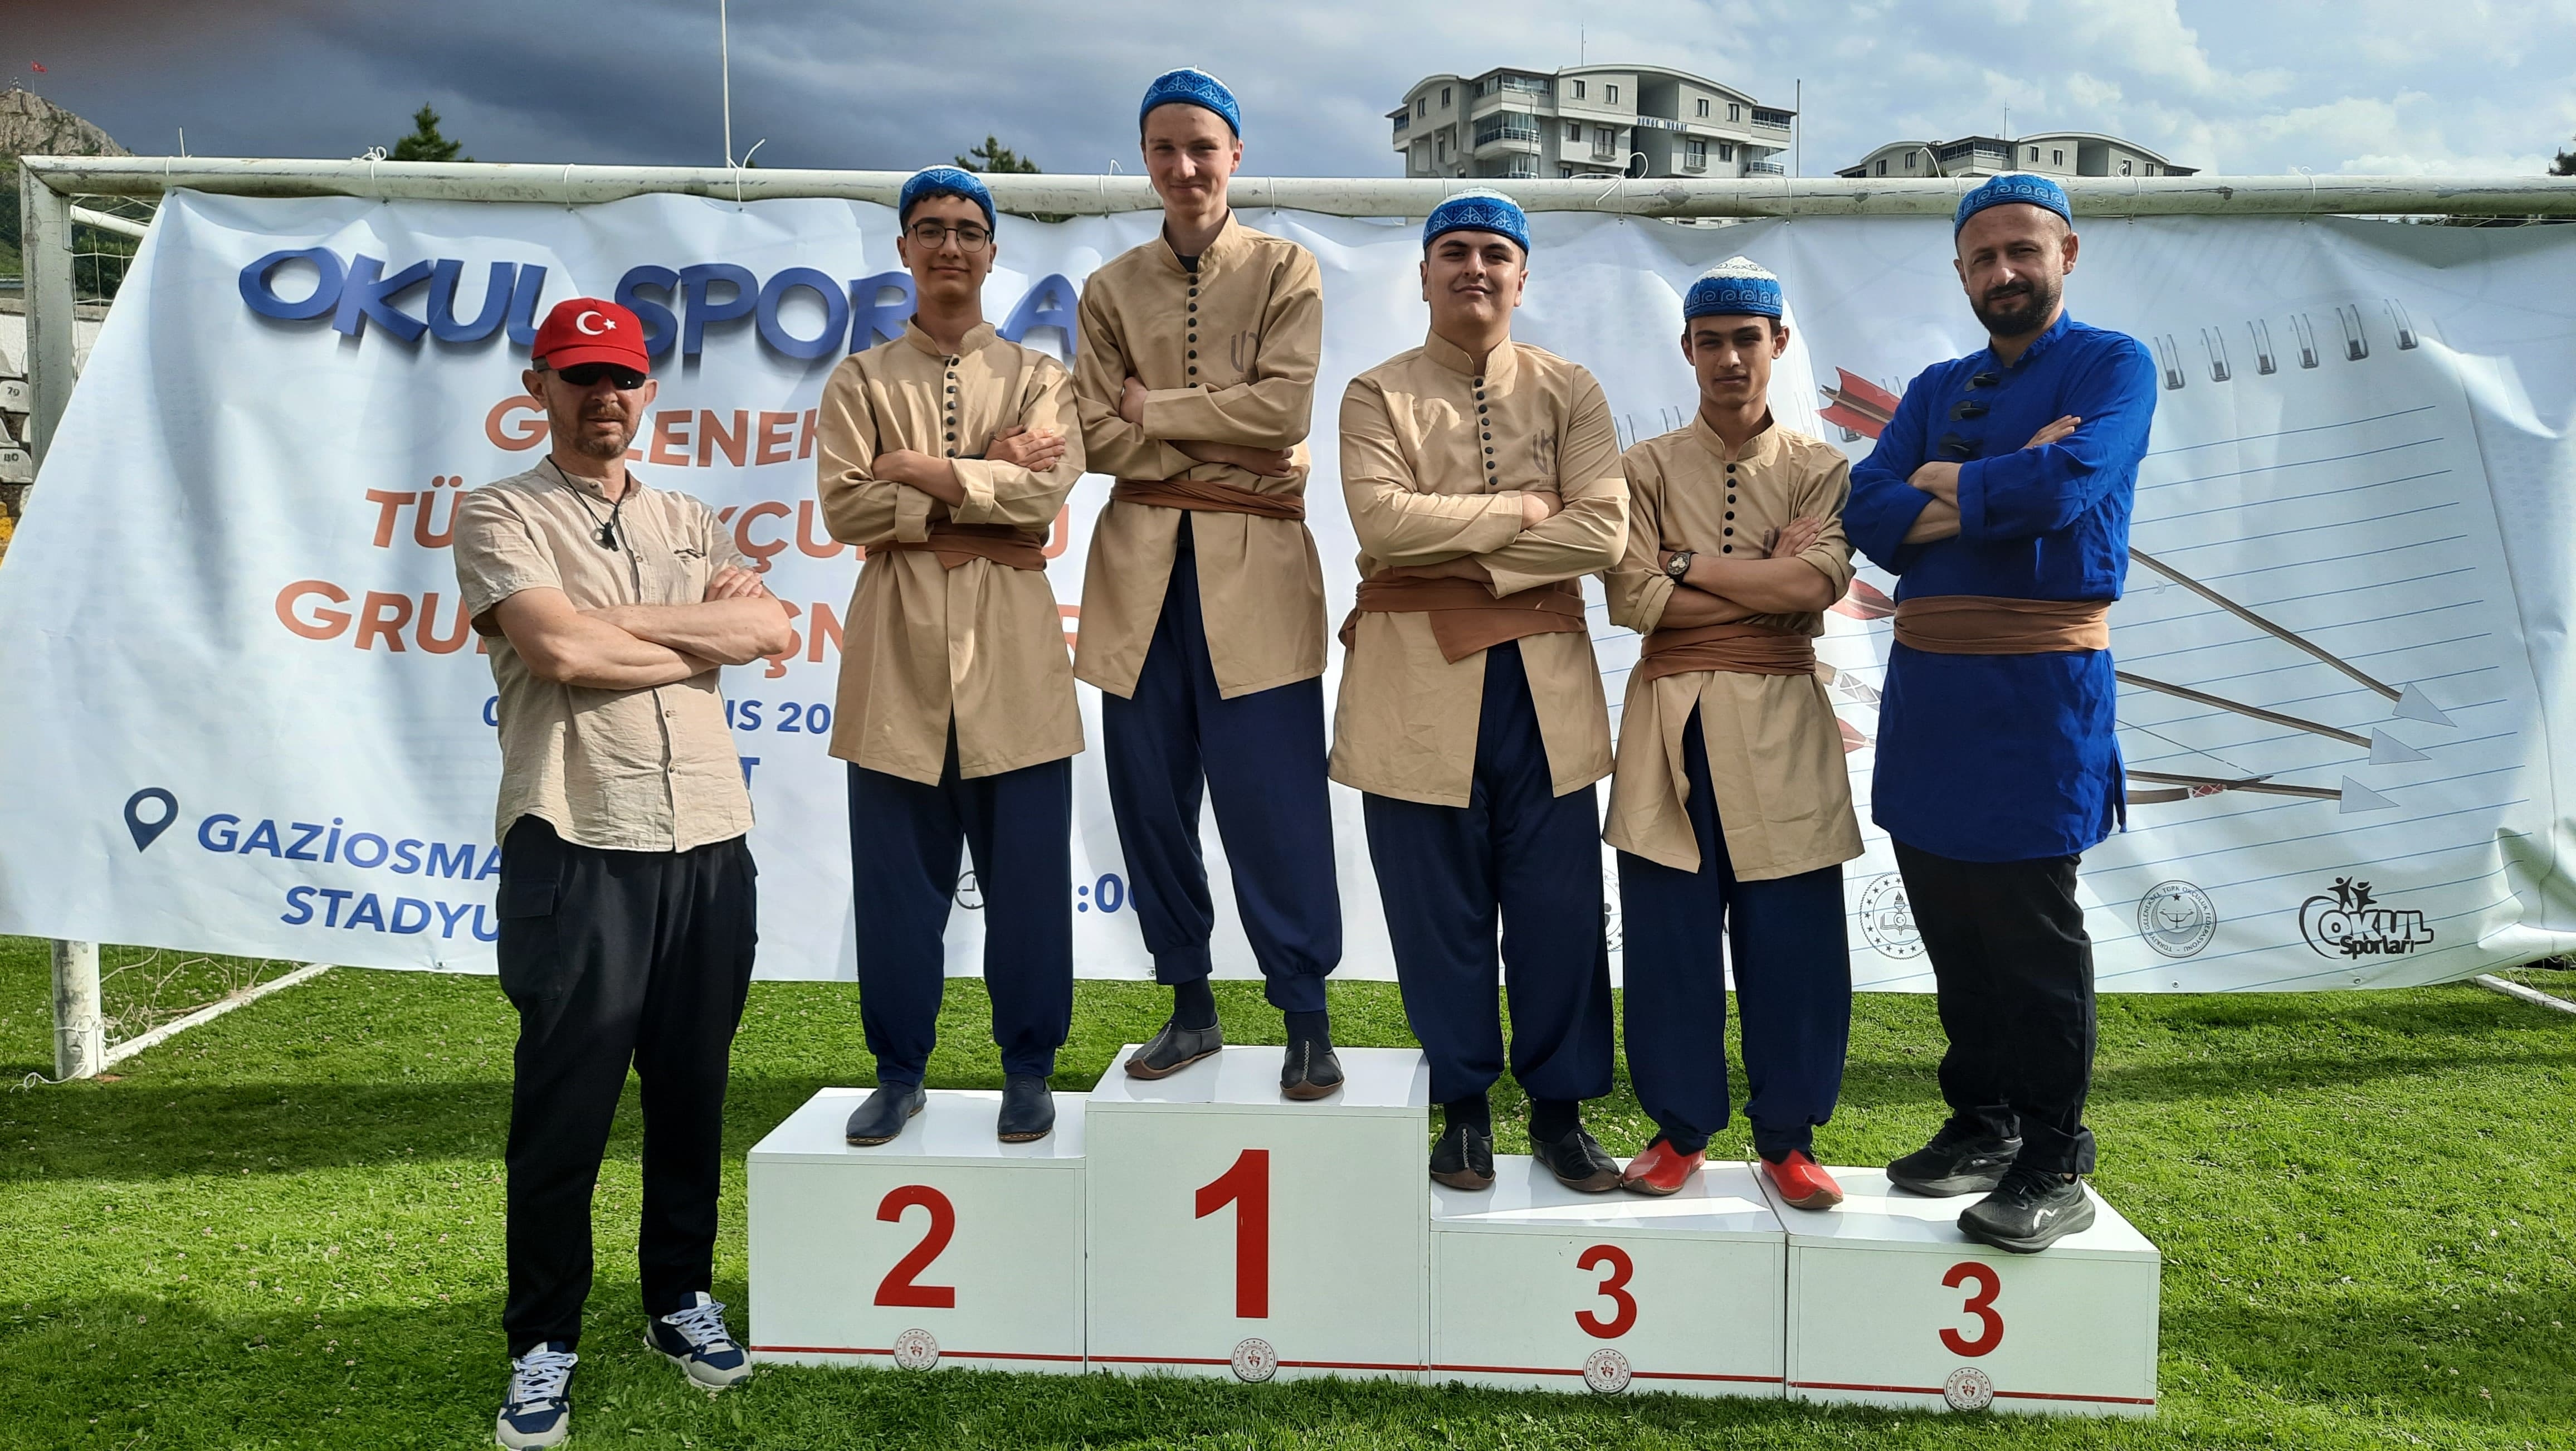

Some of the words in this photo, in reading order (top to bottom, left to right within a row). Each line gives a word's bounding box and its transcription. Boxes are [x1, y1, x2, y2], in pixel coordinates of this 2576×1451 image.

[238, 246, 547, 347] OKUL
[275, 580, 489, 654] GRU
[198, 814, 501, 880] GAZİOSMA
[280, 885, 499, 942] STADYU
[2318, 909, 2434, 946] OKUL
[874, 1185, 955, 1308] 2
[1195, 1149, 1269, 1318] 1
[1574, 1244, 1637, 1339] 3
[1938, 1262, 2004, 1357] 3
